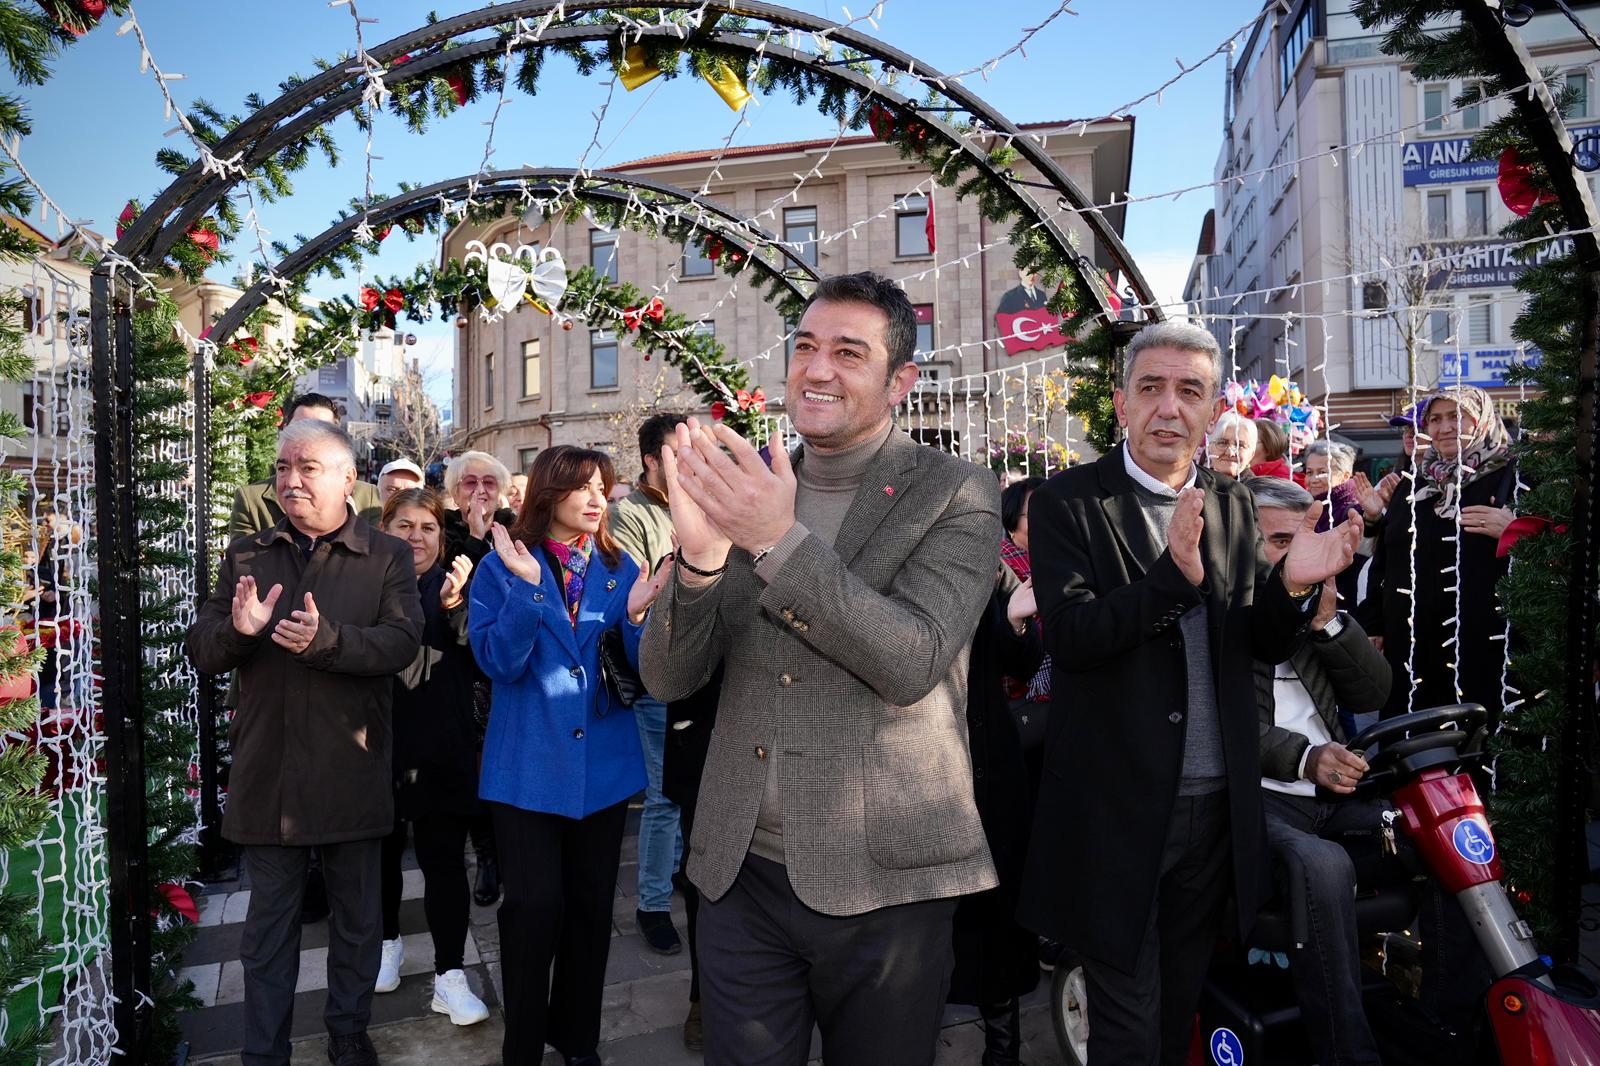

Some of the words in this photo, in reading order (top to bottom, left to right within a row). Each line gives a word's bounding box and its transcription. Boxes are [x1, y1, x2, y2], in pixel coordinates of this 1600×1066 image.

[1403, 143, 1422, 164] A
[1429, 140, 1471, 165] ANA
[1429, 167, 1469, 179] GİRESUN
[1471, 164, 1498, 176] MERK
[1448, 272, 1495, 284] GİRESUN
[1497, 269, 1507, 281] İL
